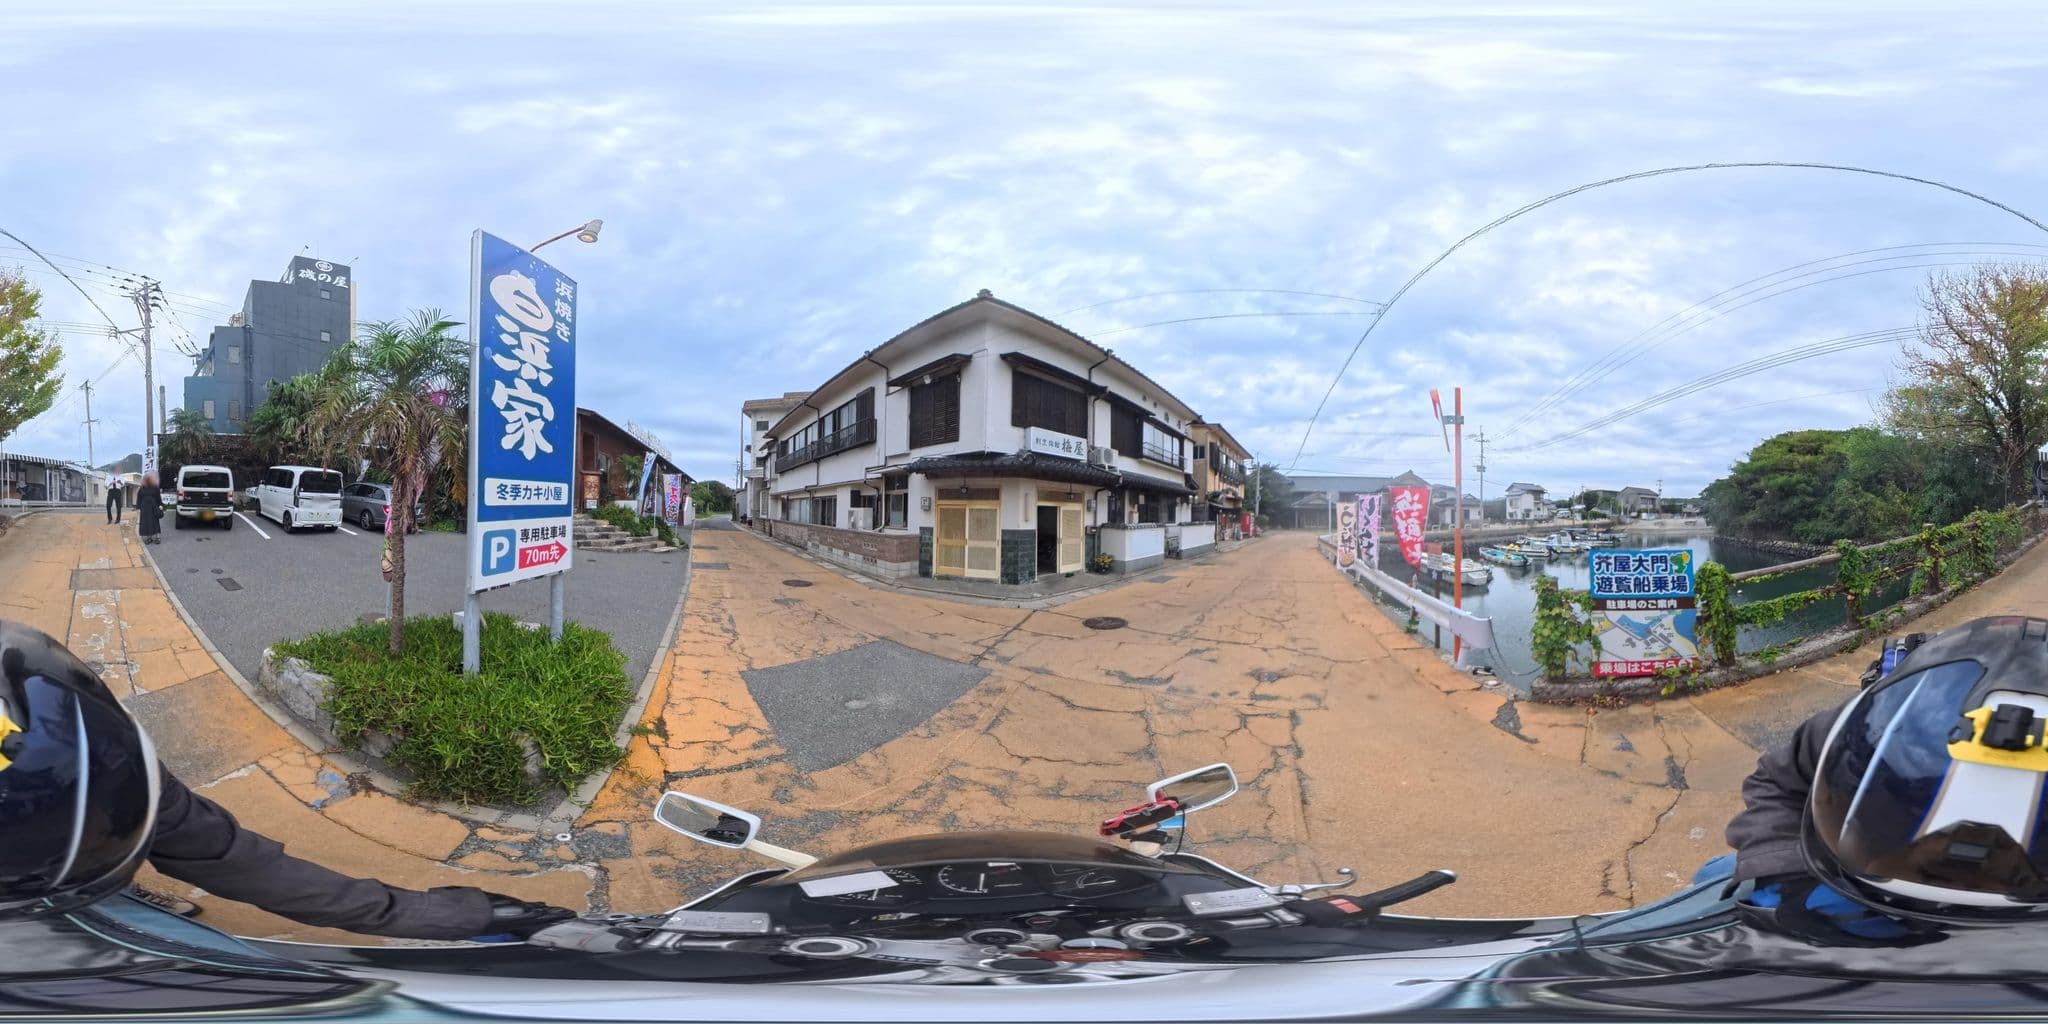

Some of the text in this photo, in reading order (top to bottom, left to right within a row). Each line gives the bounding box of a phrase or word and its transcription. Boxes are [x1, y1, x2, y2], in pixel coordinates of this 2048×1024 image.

[299, 268, 348, 288] 磯の屋
[555, 278, 574, 342] 浜焼き
[490, 272, 555, 461] 白浜家
[1062, 438, 1084, 456] 梅屋
[496, 483, 563, 501] 冬季カキ小屋
[520, 525, 567, 543] 専用駐車場
[490, 536, 510, 569] P
[526, 544, 560, 565] 70m先
[1595, 555, 1669, 573] 芥屋大門
[1596, 575, 1688, 593] 遊覧船乗場
[1606, 599, 1678, 609] 駐車場のご案内
